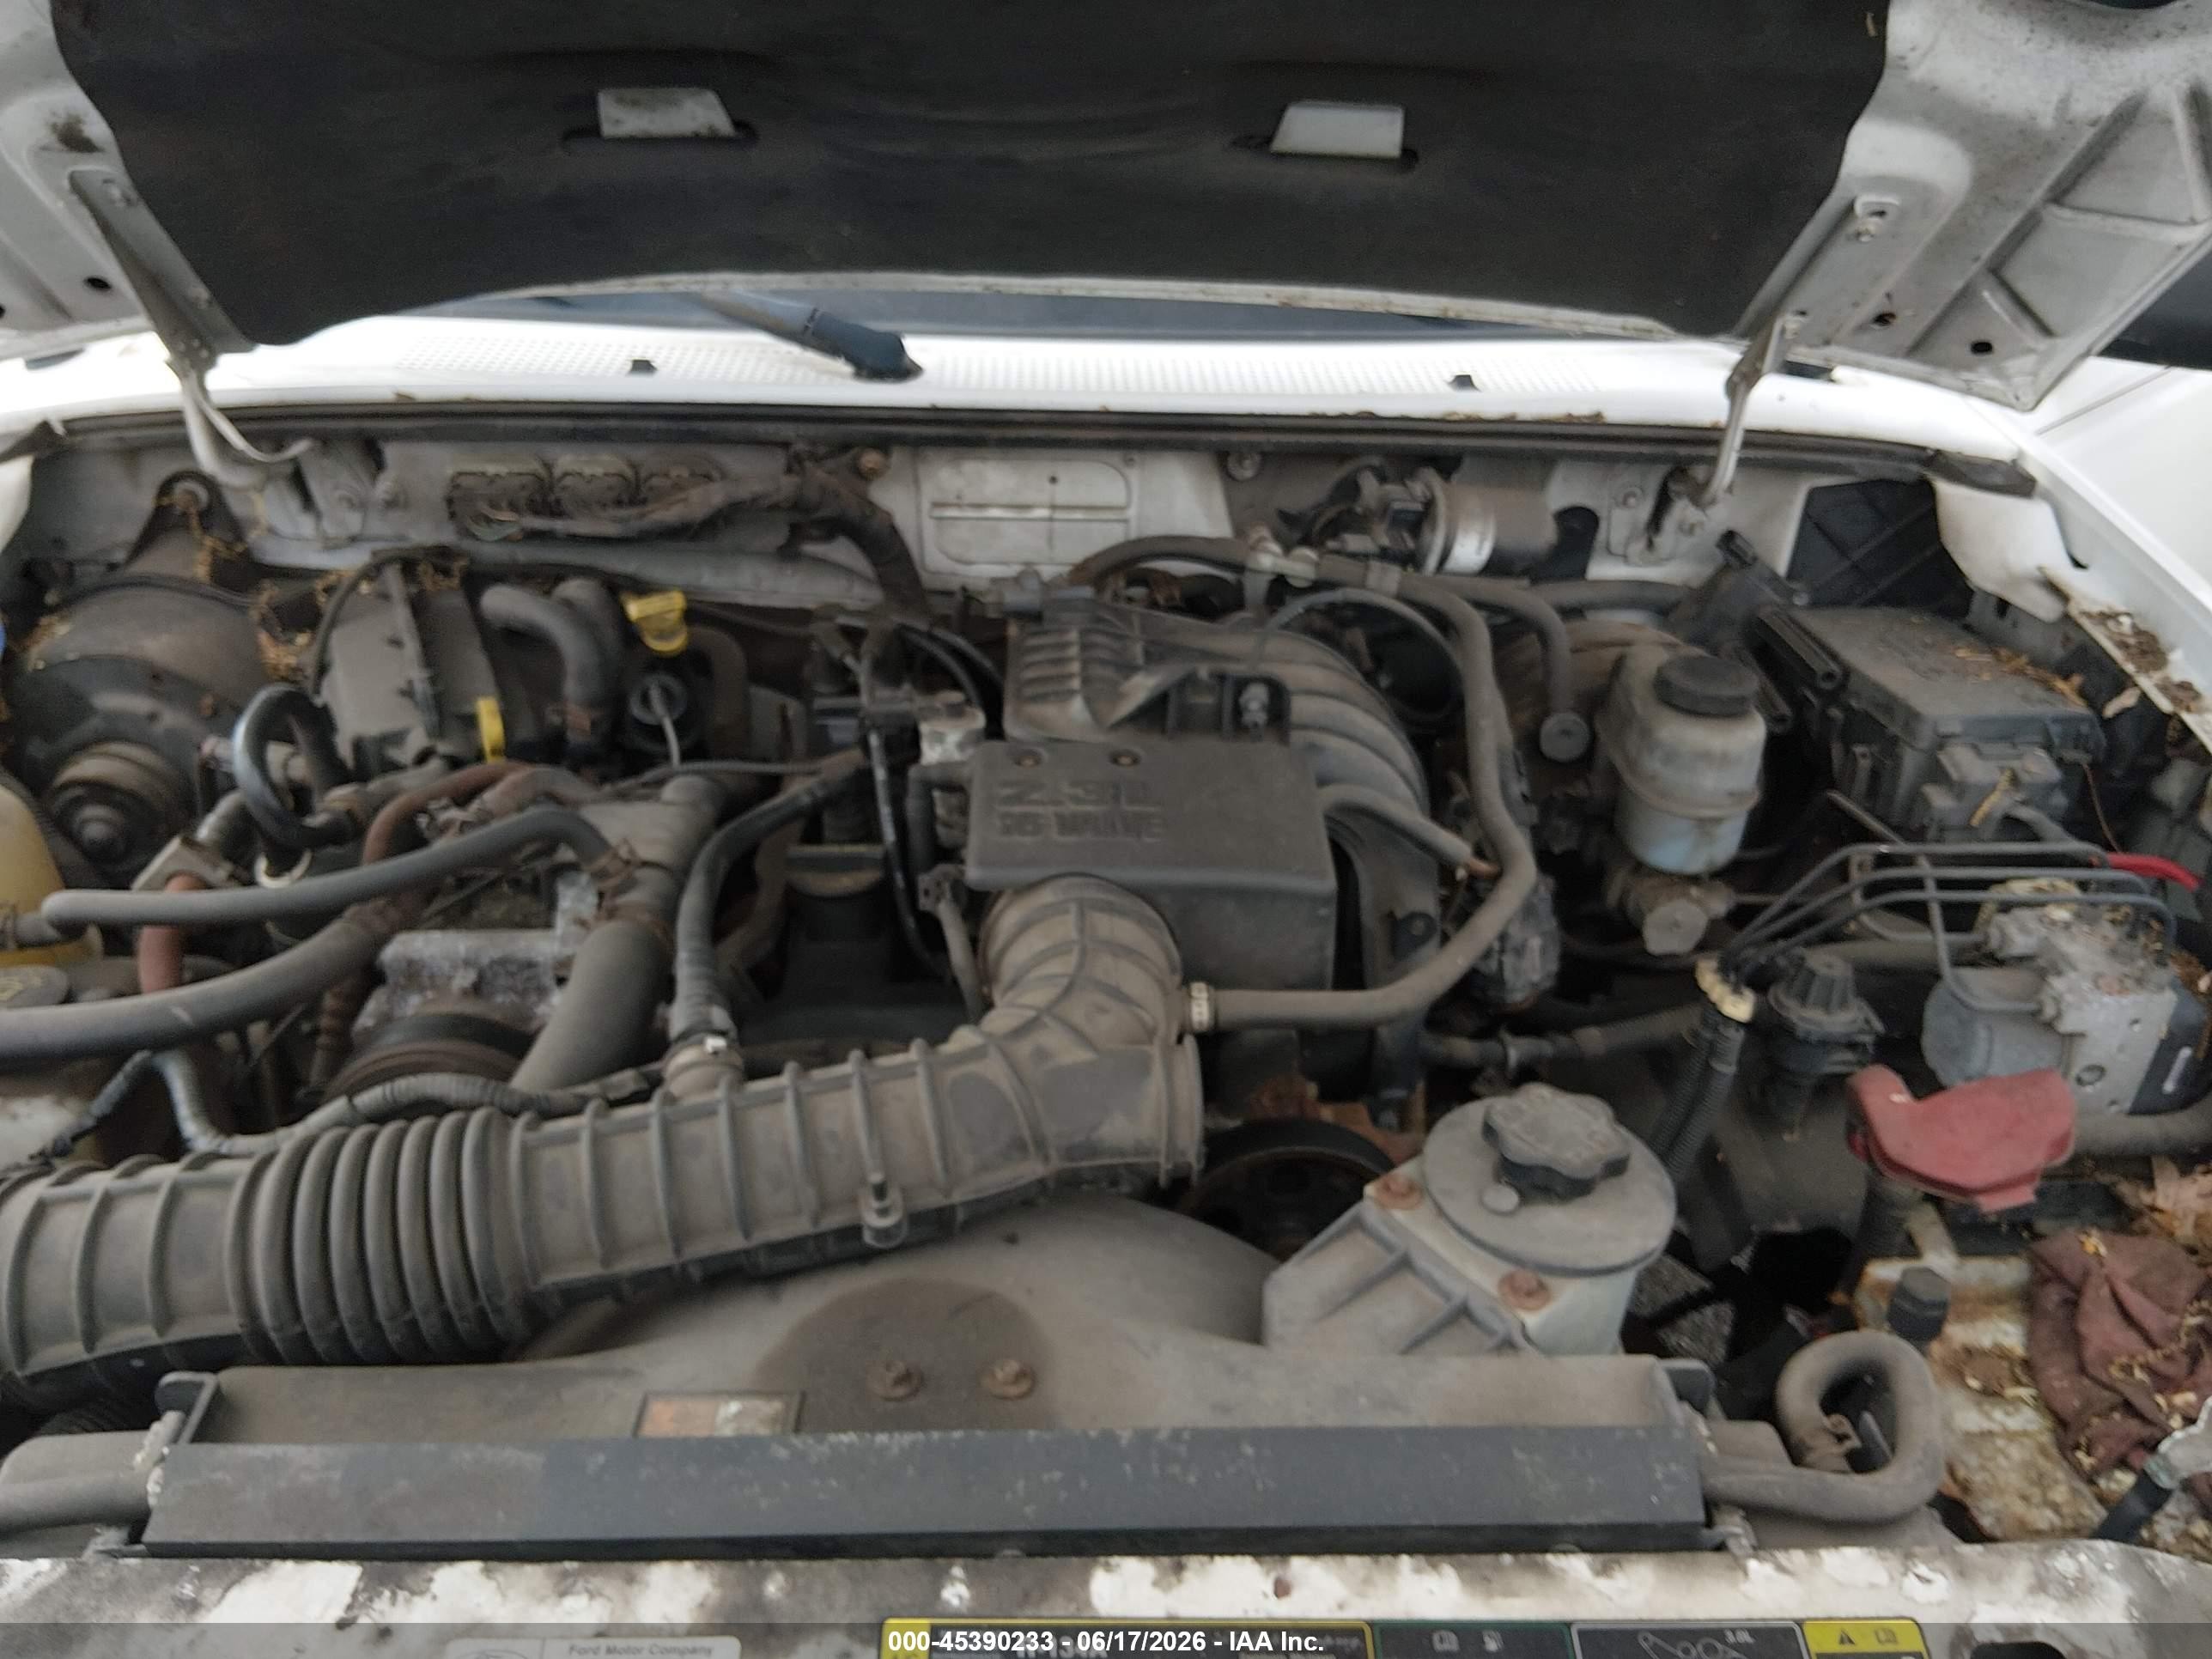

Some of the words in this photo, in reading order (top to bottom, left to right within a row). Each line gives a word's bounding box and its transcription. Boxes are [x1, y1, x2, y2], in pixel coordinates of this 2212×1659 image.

[569, 1644, 599, 1656] Ford
[605, 1644, 644, 1656] Motor
[648, 1644, 712, 1658] Company
